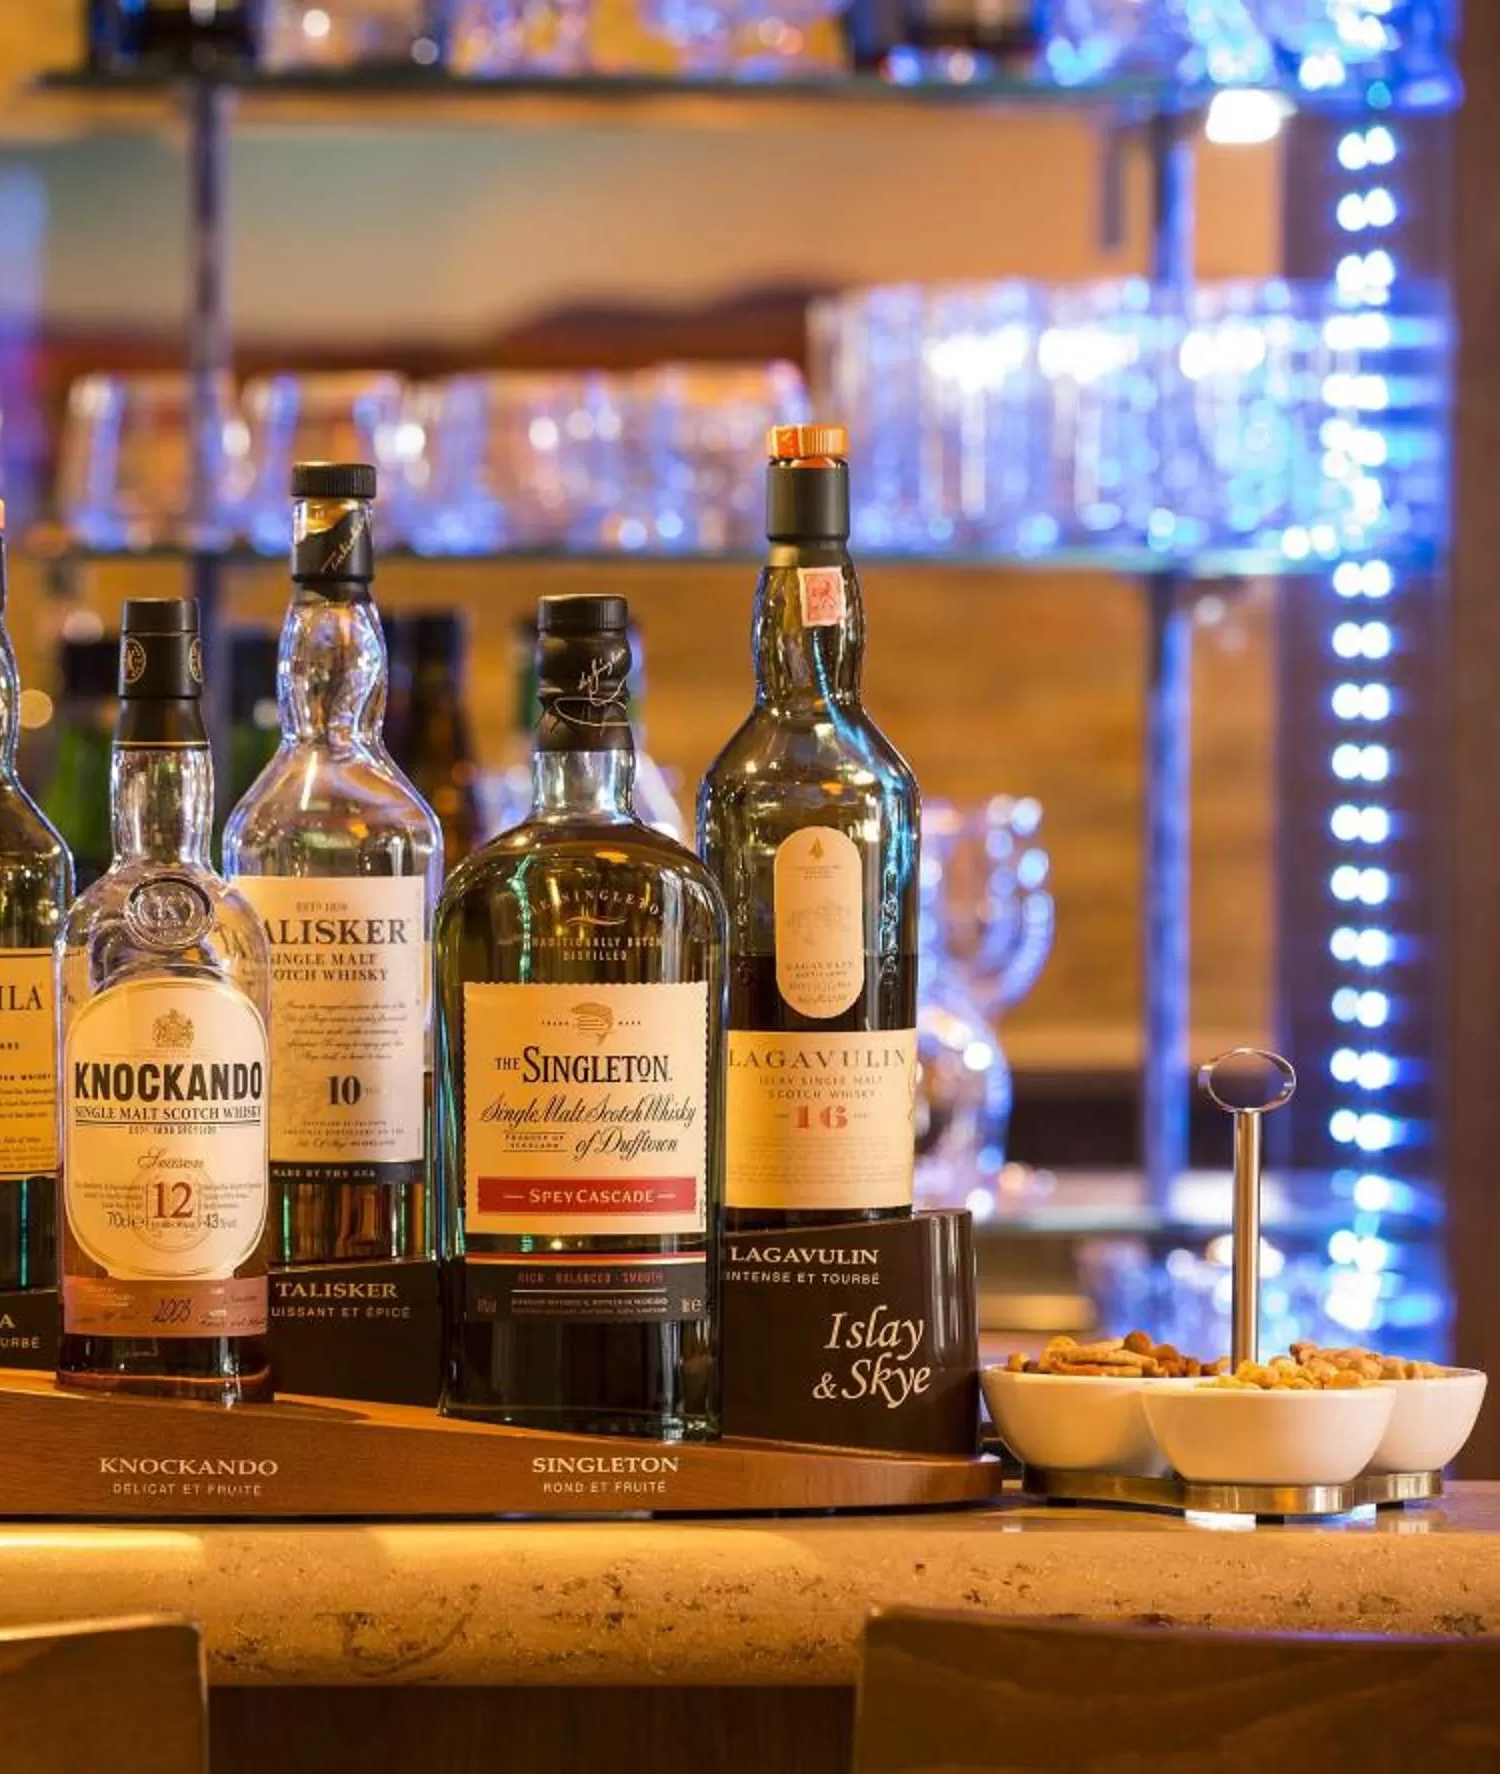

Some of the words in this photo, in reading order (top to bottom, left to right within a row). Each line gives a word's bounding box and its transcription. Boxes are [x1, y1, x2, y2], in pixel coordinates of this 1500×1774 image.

[263, 919, 408, 945] ALISKER
[331, 953, 378, 965] MALT
[273, 969, 317, 981] OTCH
[322, 969, 388, 981] WHISKY
[494, 1057, 520, 1070] THE
[728, 1048, 905, 1069] LAGAVULIN
[75, 1061, 262, 1102] KNOCKANDO
[329, 1075, 362, 1106] 10
[769, 1090, 821, 1100] SCOTCH
[75, 1106, 116, 1119] SINGLE
[119, 1107, 157, 1120] MALT
[163, 1107, 219, 1120] SCOTCH
[481, 1091, 539, 1128] Single
[542, 1093, 585, 1123] Malt
[585, 1093, 645, 1123] Scotch
[642, 1093, 697, 1127] Whisky
[793, 1104, 849, 1129] 16
[573, 1130, 600, 1161] of
[594, 1125, 678, 1161] Dufftown
[152, 1181, 193, 1219] 12
[529, 1188, 574, 1204] SPEY
[575, 1189, 655, 1204] CASCADE
[730, 1246, 880, 1265] LAGAVULIN
[725, 1271, 791, 1283] INTENSE
[797, 1273, 814, 1283] ET
[821, 1272, 880, 1285] TOURBÉ
[276, 1282, 399, 1298] TALISKER
[271, 1306, 334, 1318] UISSANT
[341, 1307, 359, 1318] ET
[823, 1305, 925, 1361] Islay
[812, 1372, 837, 1400] &
[841, 1351, 932, 1409] Skye
[100, 1457, 279, 1477] KNOCKANDO
[532, 1457, 680, 1473] SINGLETON
[183, 1483, 200, 1496] ET
[543, 1481, 584, 1493] ROND
[590, 1481, 608, 1493] ET
